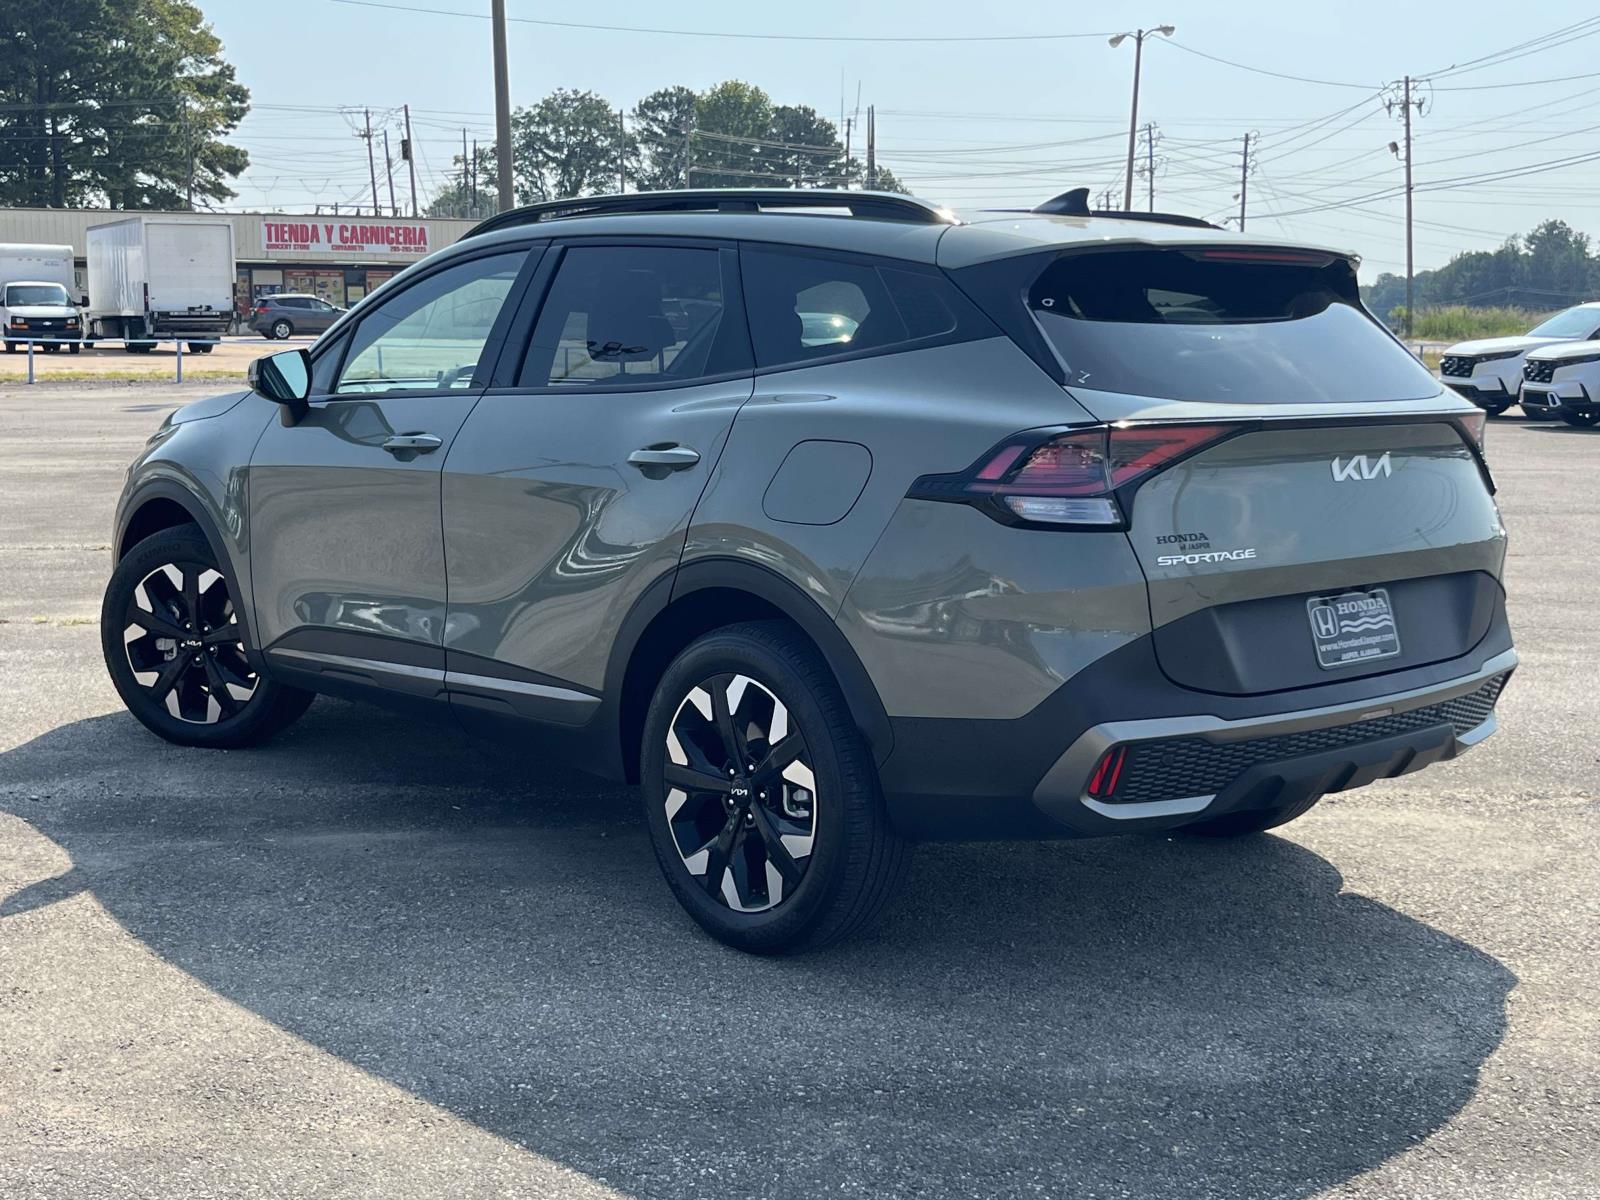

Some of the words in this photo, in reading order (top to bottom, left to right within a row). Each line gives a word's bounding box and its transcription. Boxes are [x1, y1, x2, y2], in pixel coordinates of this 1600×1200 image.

[265, 223, 320, 243] TIENDA
[324, 224, 334, 244] Y
[339, 224, 428, 246] CARNICERIA
[1331, 453, 1392, 482] KIA
[1155, 532, 1209, 545] HONDA
[1157, 548, 1257, 566] SPORTAGE
[1336, 597, 1387, 615] HONDA
